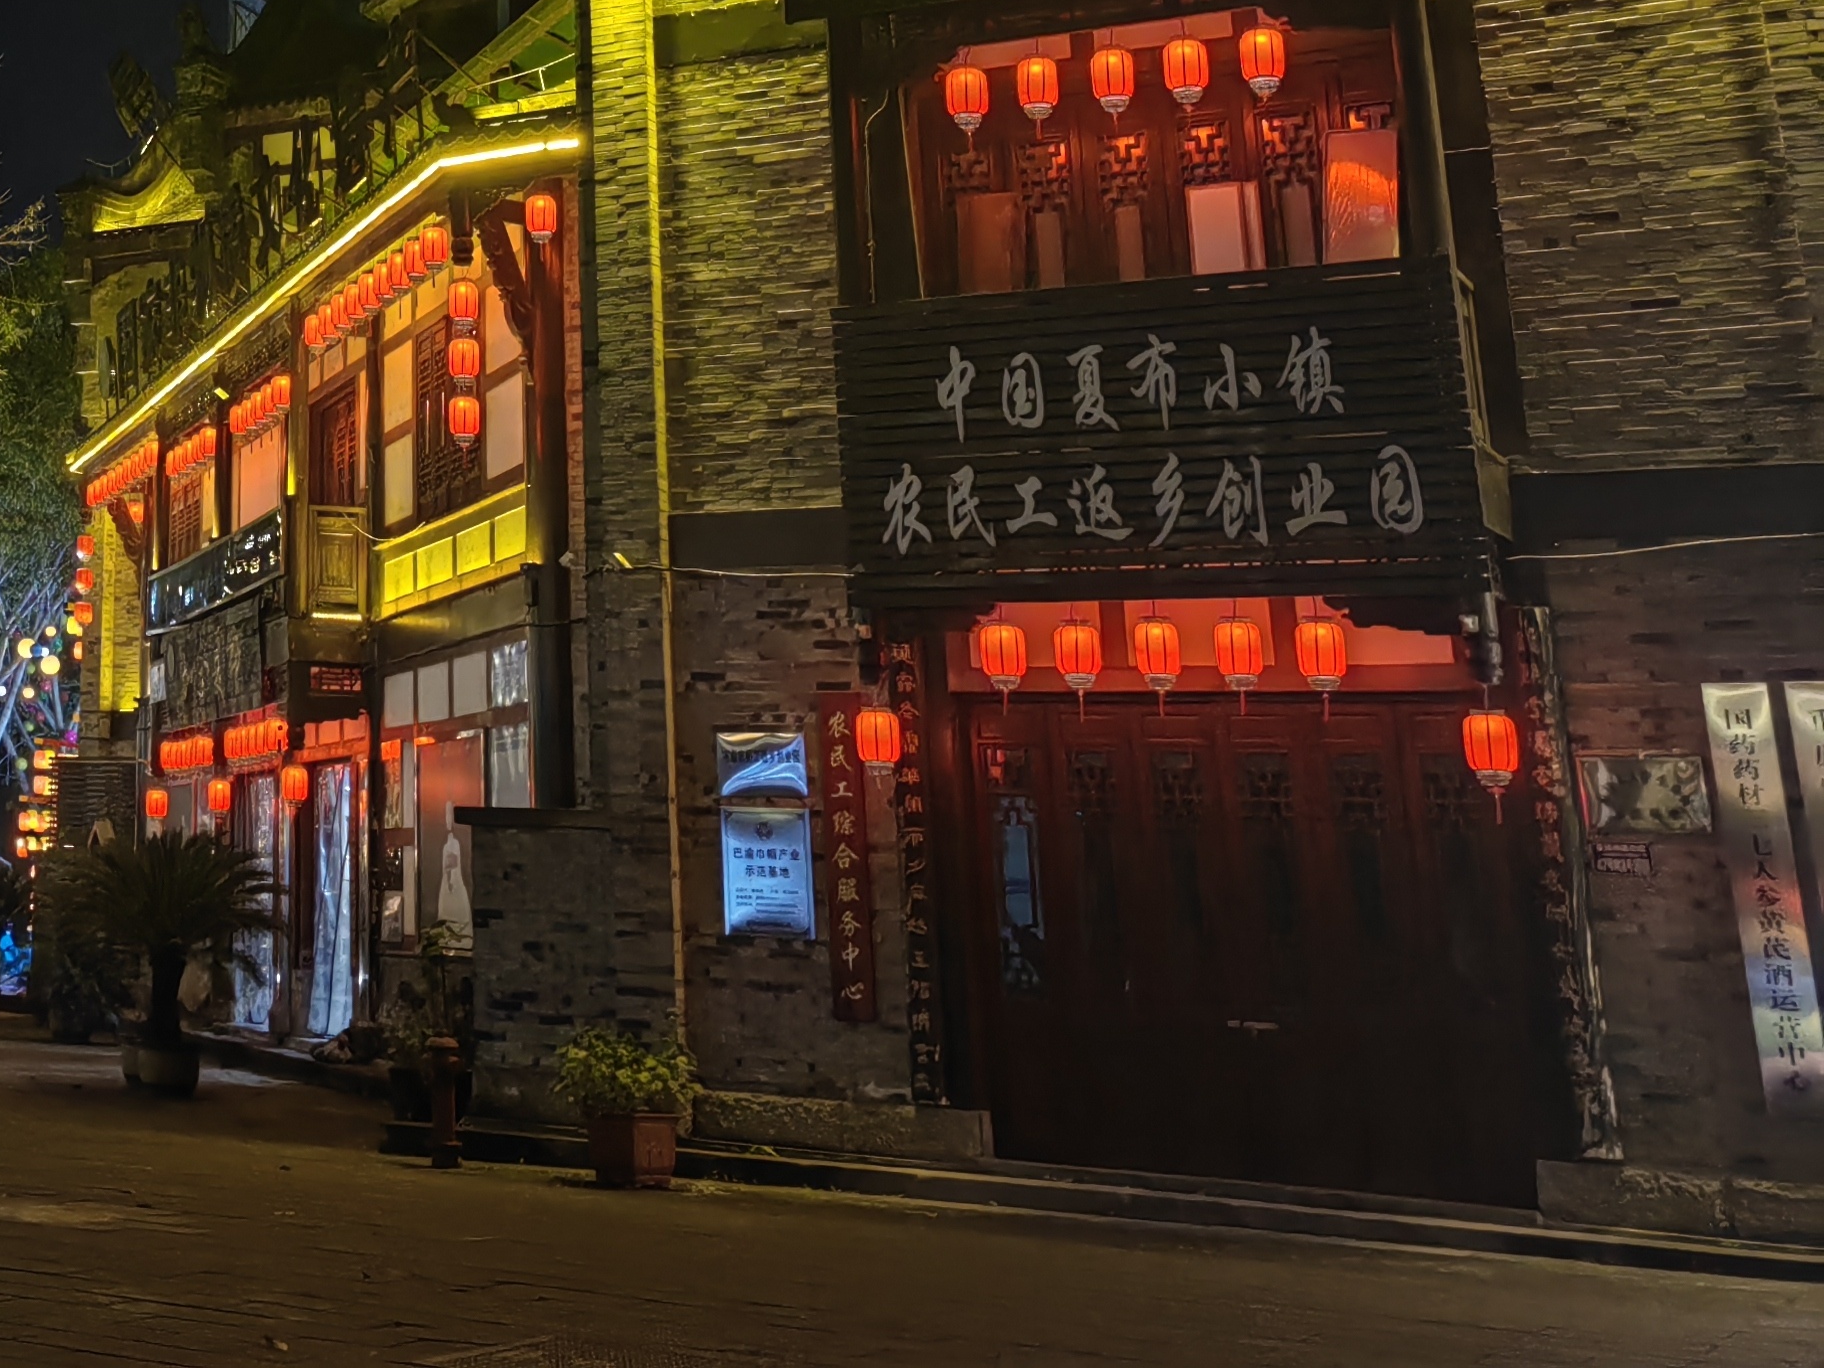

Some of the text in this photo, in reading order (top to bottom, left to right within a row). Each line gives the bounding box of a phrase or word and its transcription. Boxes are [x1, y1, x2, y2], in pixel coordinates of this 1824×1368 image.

[934, 326, 1346, 443] 中国夏布小镇
[881, 444, 1424, 554] 农民工返乡创业园
[827, 710, 865, 1001] 农民工综合服务中心
